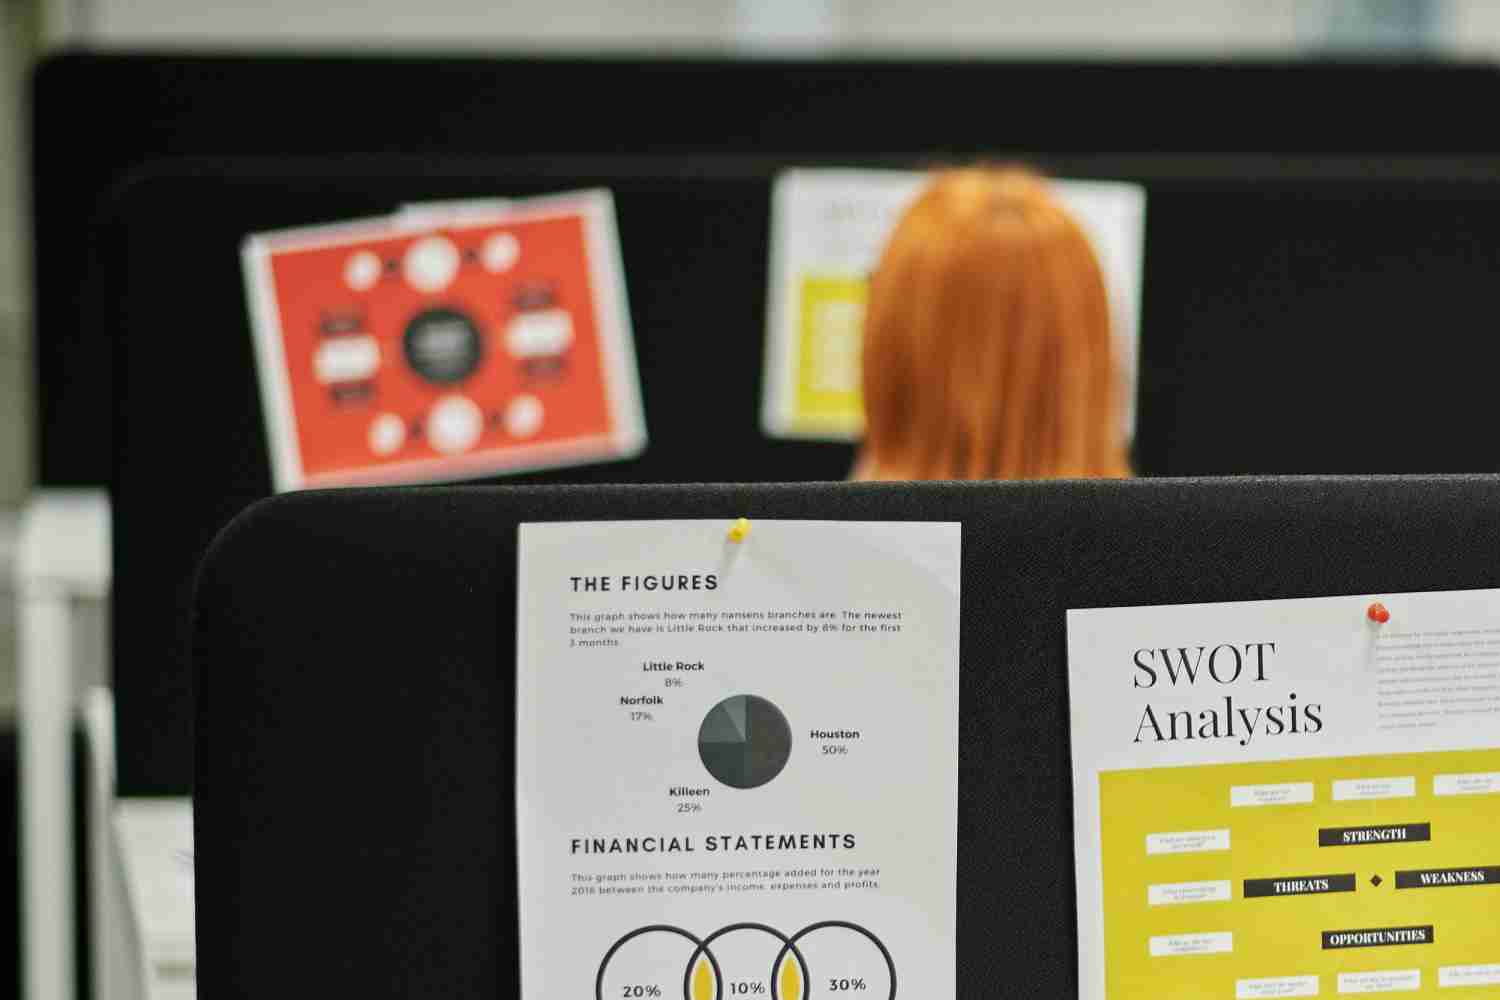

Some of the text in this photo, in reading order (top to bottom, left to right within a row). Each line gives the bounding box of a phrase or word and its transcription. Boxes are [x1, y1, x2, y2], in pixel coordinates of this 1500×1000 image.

[571, 573, 719, 592] THE FIGURES
[570, 611, 590, 621] This
[594, 612, 624, 623] graph
[629, 611, 660, 621] shows
[664, 610, 686, 620] how
[688, 611, 718, 623] many
[767, 609, 816, 619] branches
[842, 610, 860, 619] The
[864, 610, 902, 620] newest
[569, 625, 606, 634] branch
[667, 623, 693, 632] Little
[698, 622, 722, 632] Rock
[727, 623, 749, 632] that
[752, 623, 804, 632] increased
[807, 624, 818, 634] by
[842, 624, 857, 632] for
[859, 624, 878, 632] the
[880, 623, 901, 632] first
[642, 661, 705, 672] Little Rock
[1133, 641, 1276, 690] SWOT
[619, 695, 664, 705] Norfolk
[630, 711, 654, 721] 17%
[1133, 692, 1323, 746] Analysis
[809, 728, 861, 740] Houston
[669, 785, 711, 797] Killeen
[677, 803, 703, 814] 25%
[1343, 828, 1407, 843] STRENGTH
[571, 834, 856, 855] FINANCIAL STATEMENTS
[595, 873, 625, 884] graph
[665, 872, 686, 881] how
[721, 870, 780, 881] percentage
[783, 868, 816, 878] added
[820, 868, 834, 877] for
[838, 867, 855, 877] the
[857, 868, 880, 880] year
[1420, 869, 1485, 885] WEAKNESS
[647, 885, 664, 894] the
[769, 881, 817, 892] expenses
[821, 880, 841, 890] and
[1273, 878, 1329, 893] THREATS
[1330, 928, 1426, 945] OPPORTUNITIES
[623, 985, 661, 998] 20%
[730, 981, 766, 995] 10%
[829, 978, 866, 992] 30%
